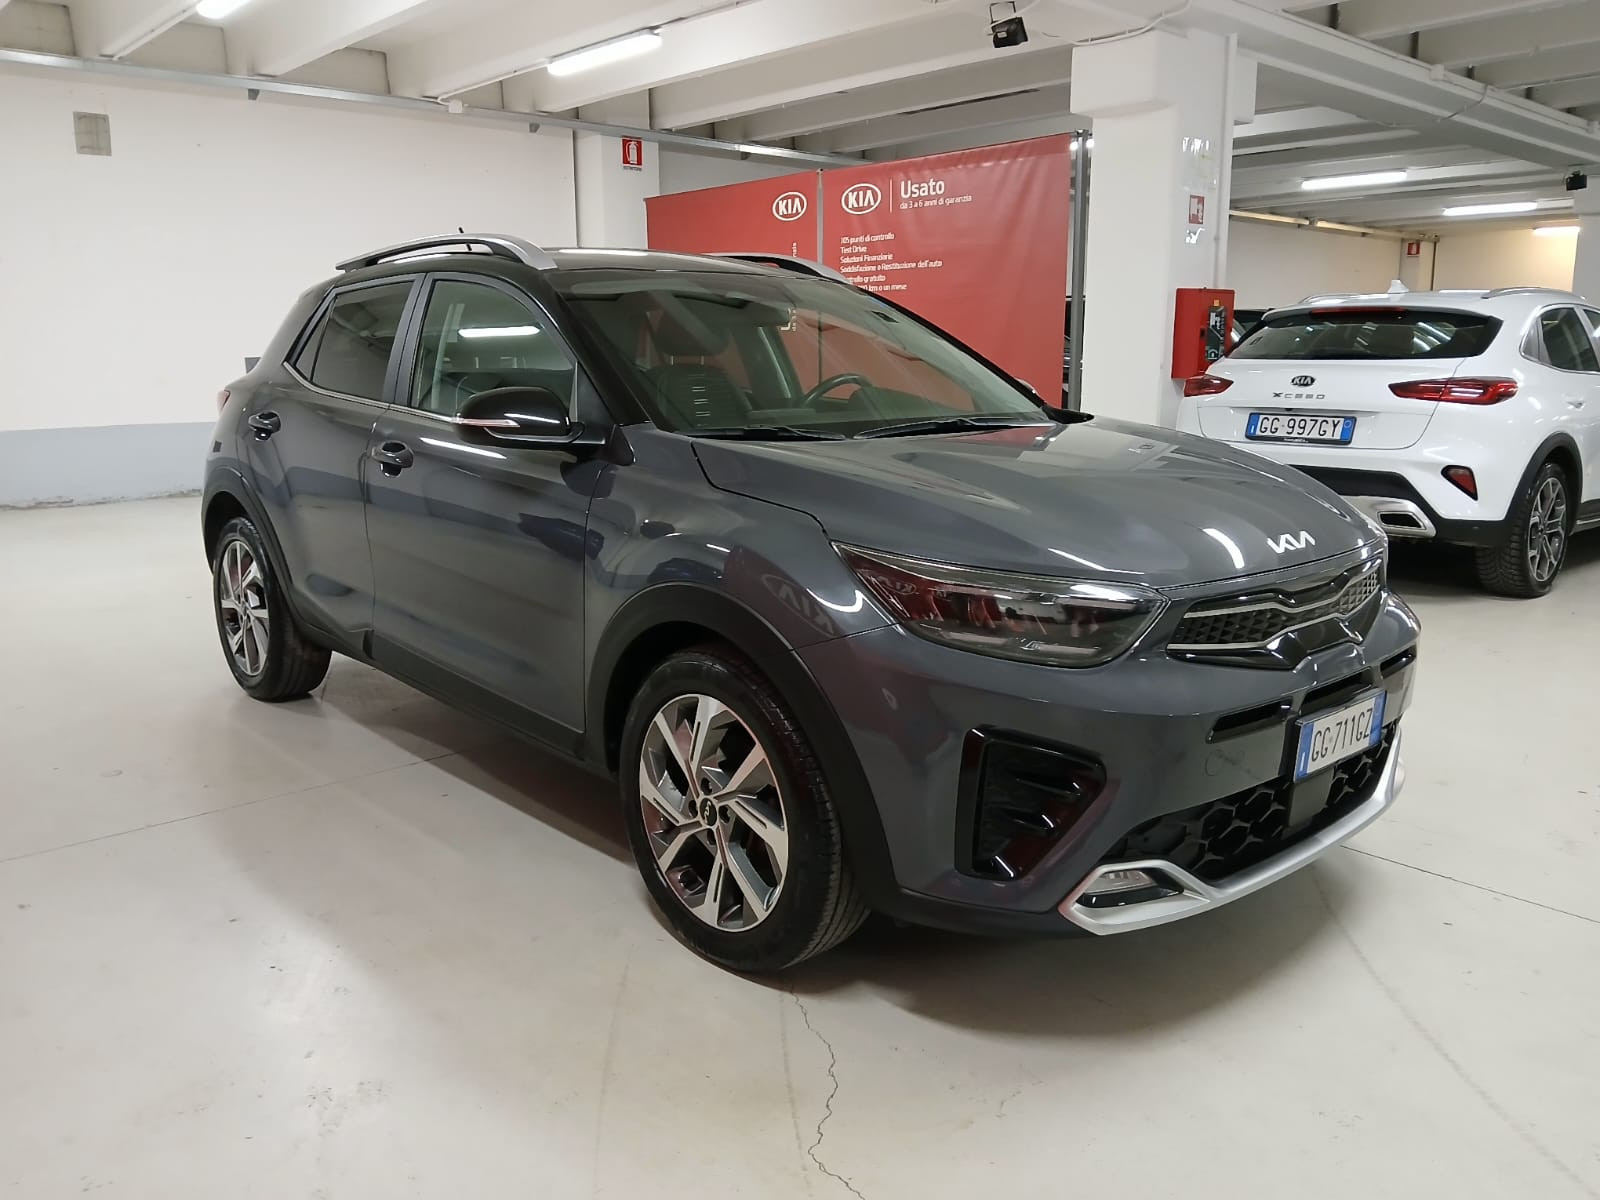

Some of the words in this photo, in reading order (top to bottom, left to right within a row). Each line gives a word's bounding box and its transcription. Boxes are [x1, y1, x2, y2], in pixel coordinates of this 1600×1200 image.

[901, 178, 945, 199] Usato
[778, 197, 802, 216] KIA
[848, 189, 875, 209] KIA
[923, 198, 937, 207] anni
[840, 246, 852, 254] Test
[852, 245, 867, 253] Drive
[1259, 417, 1280, 434] GG
[1286, 418, 1340, 437] 997GY
[1311, 727, 1331, 762] GG
[1332, 708, 1373, 754] 711GZ
